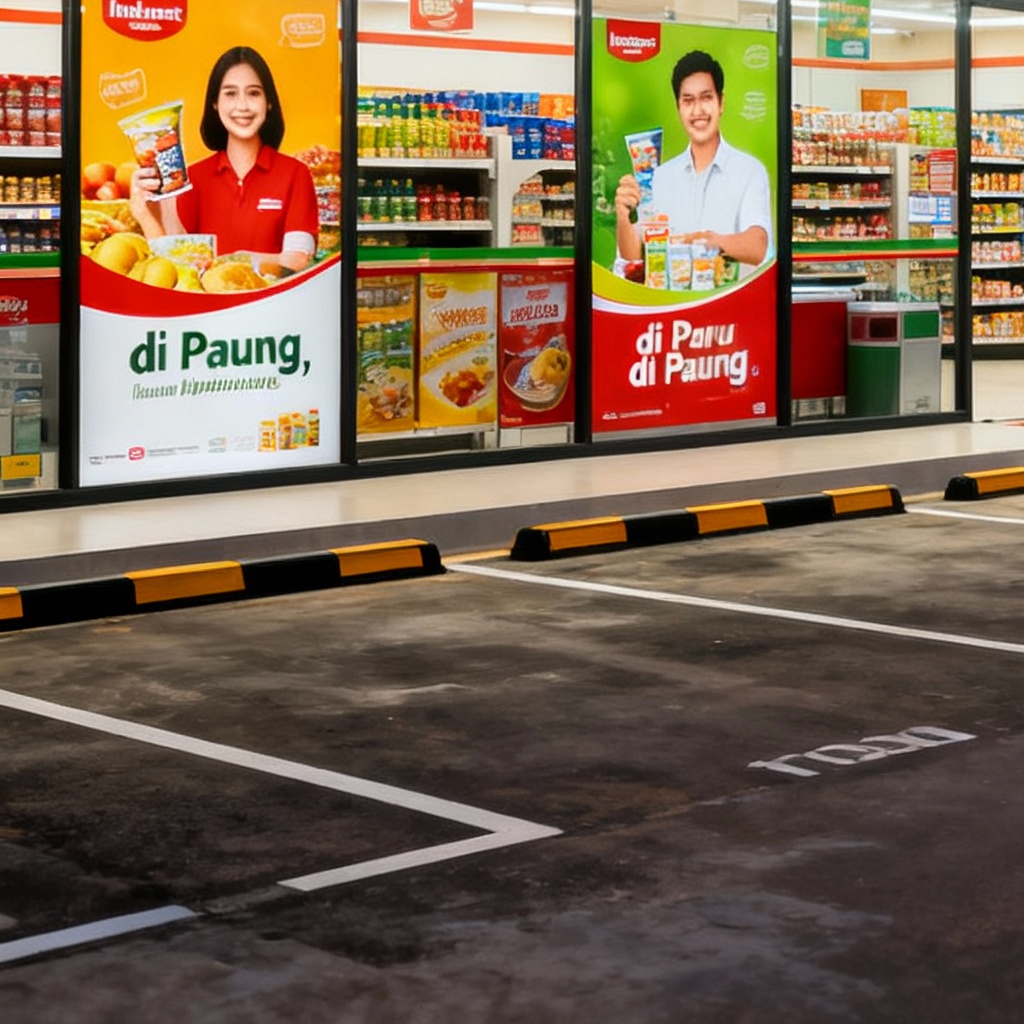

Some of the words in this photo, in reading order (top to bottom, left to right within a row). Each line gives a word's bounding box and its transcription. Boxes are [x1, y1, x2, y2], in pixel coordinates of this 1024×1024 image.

[129, 330, 167, 374] di
[181, 330, 311, 377] Paung,
[636, 321, 663, 356] di
[628, 355, 656, 388] di
[664, 349, 748, 387] Paung
